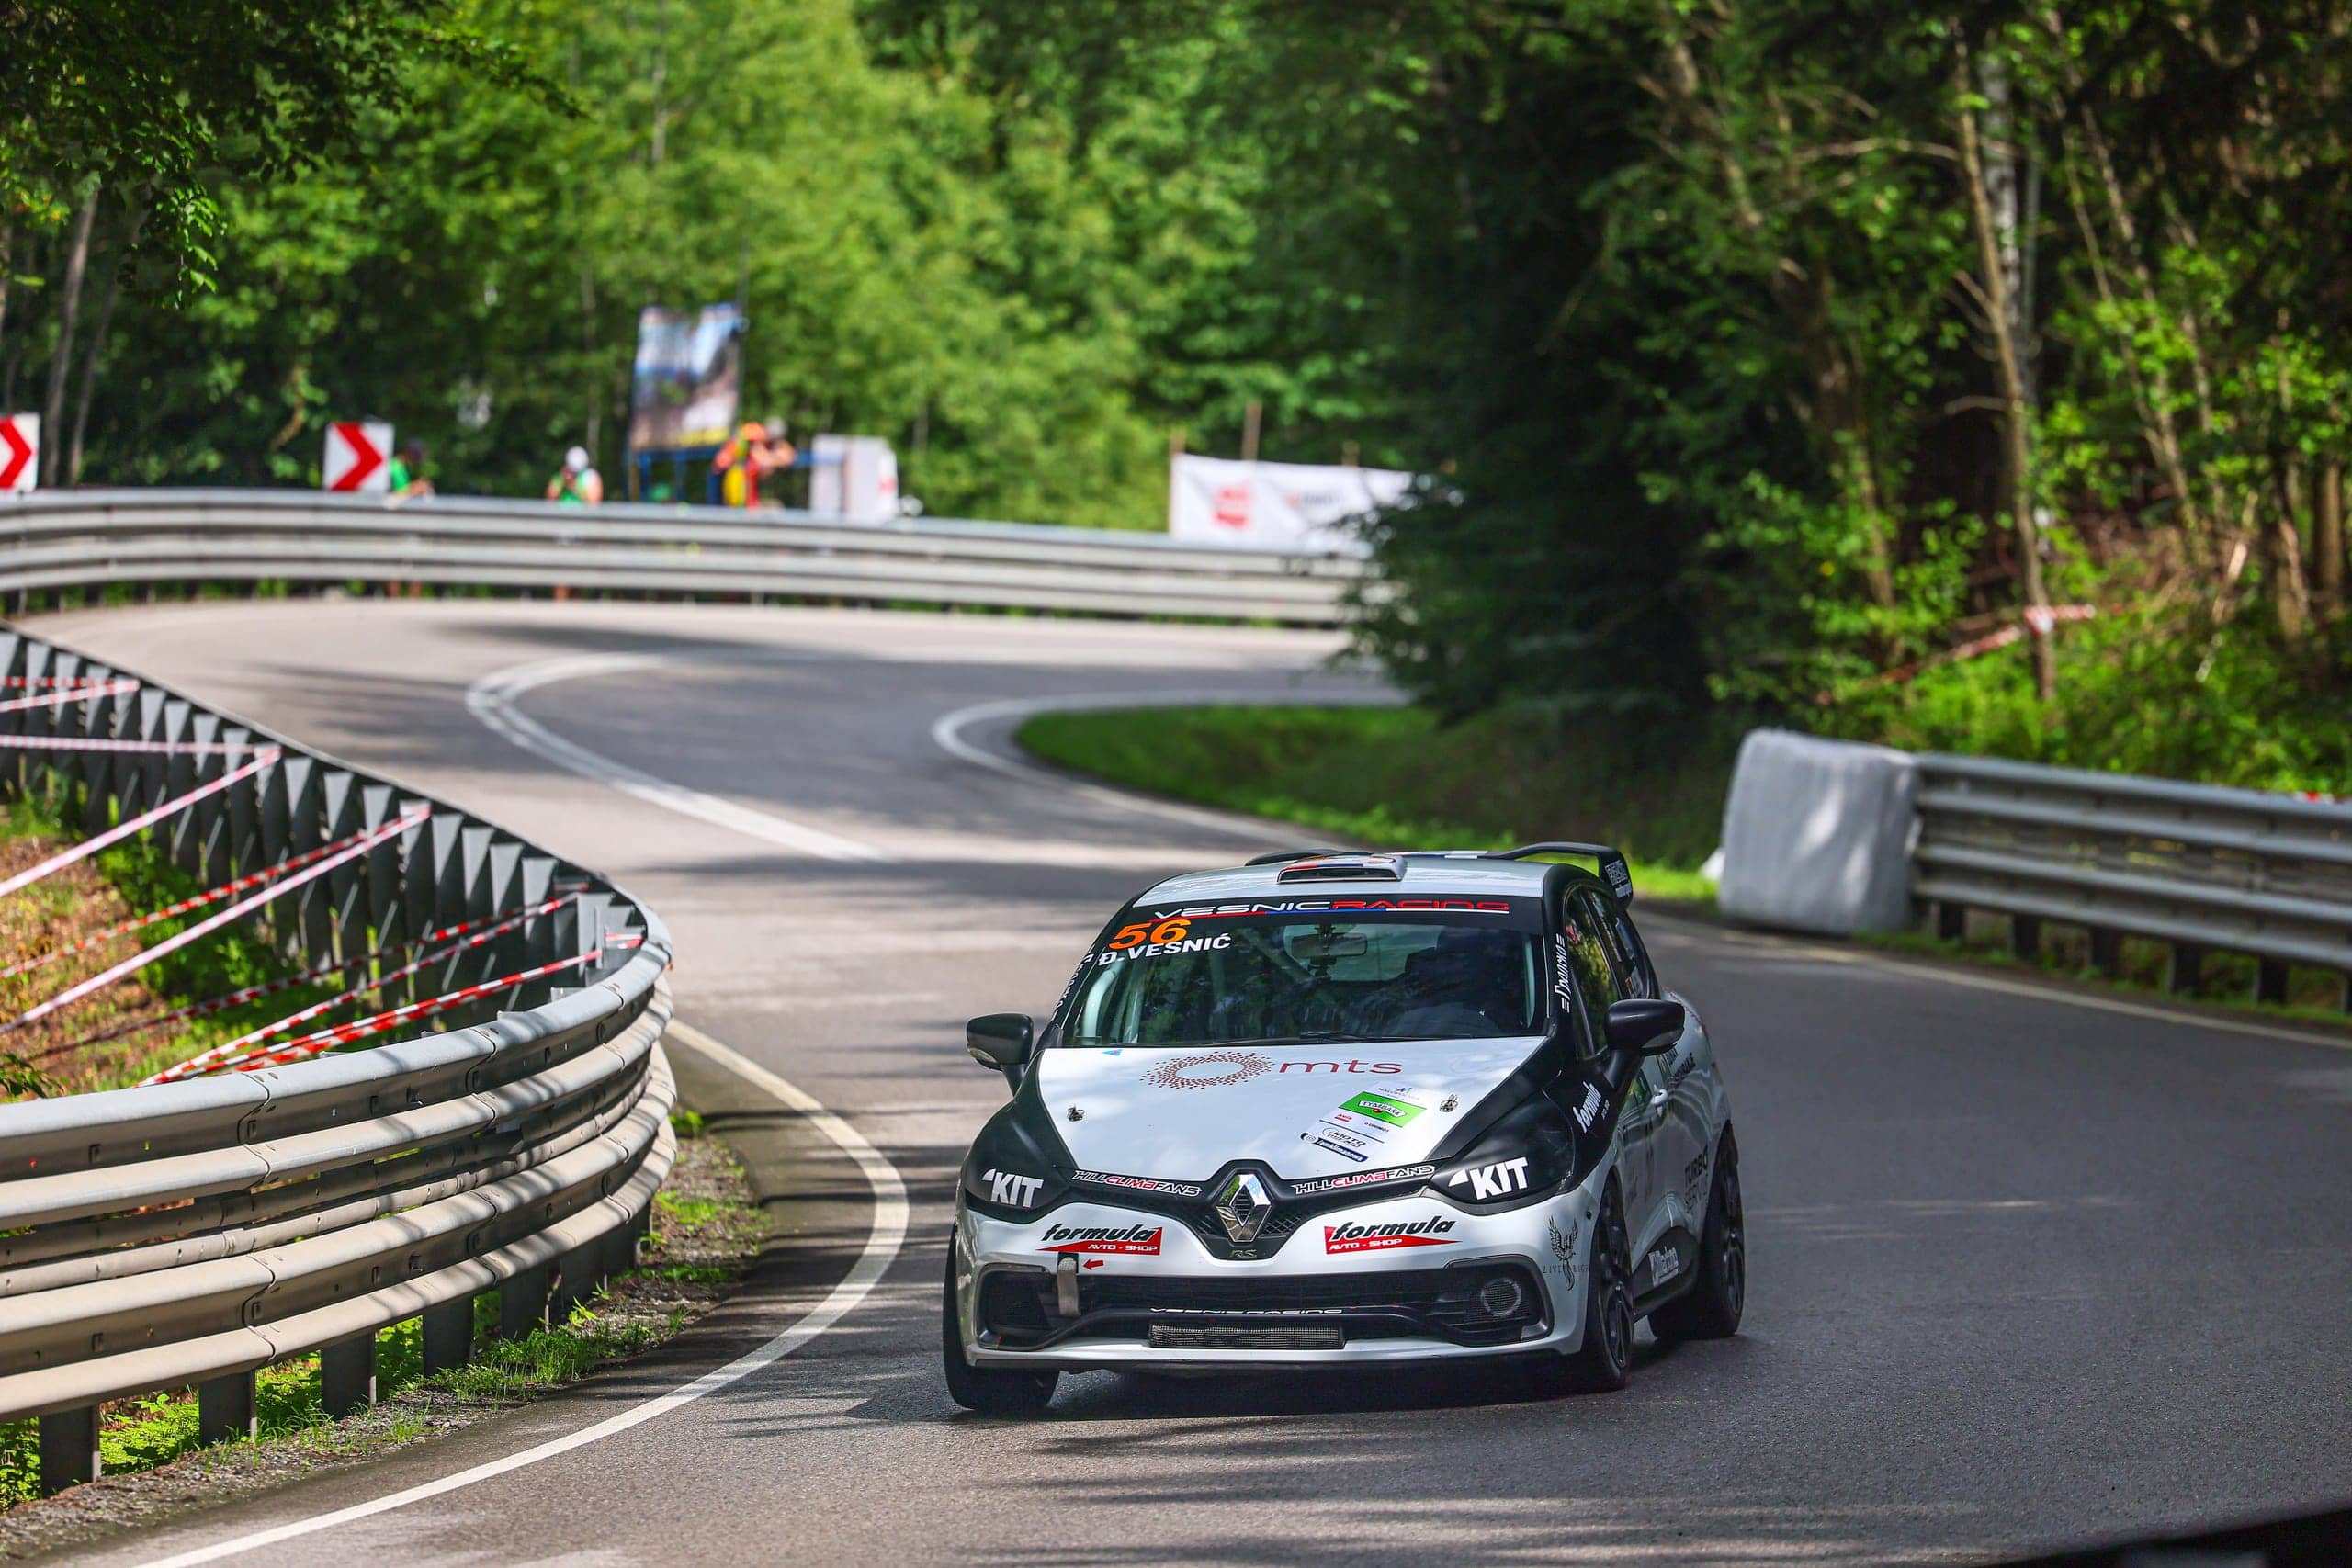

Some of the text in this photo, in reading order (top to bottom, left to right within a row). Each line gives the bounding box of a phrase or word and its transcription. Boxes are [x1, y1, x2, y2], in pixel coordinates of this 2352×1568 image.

[1108, 919, 1192, 950] 56
[1279, 1059, 1403, 1074] mts
[990, 1171, 1045, 1208] KIT
[1469, 1156, 1529, 1201] KIT
[1041, 1223, 1157, 1242] formula
[1331, 1215, 1456, 1240] formula
[1329, 1242, 1360, 1251] AVTO
[1369, 1238, 1403, 1247] SHOP
